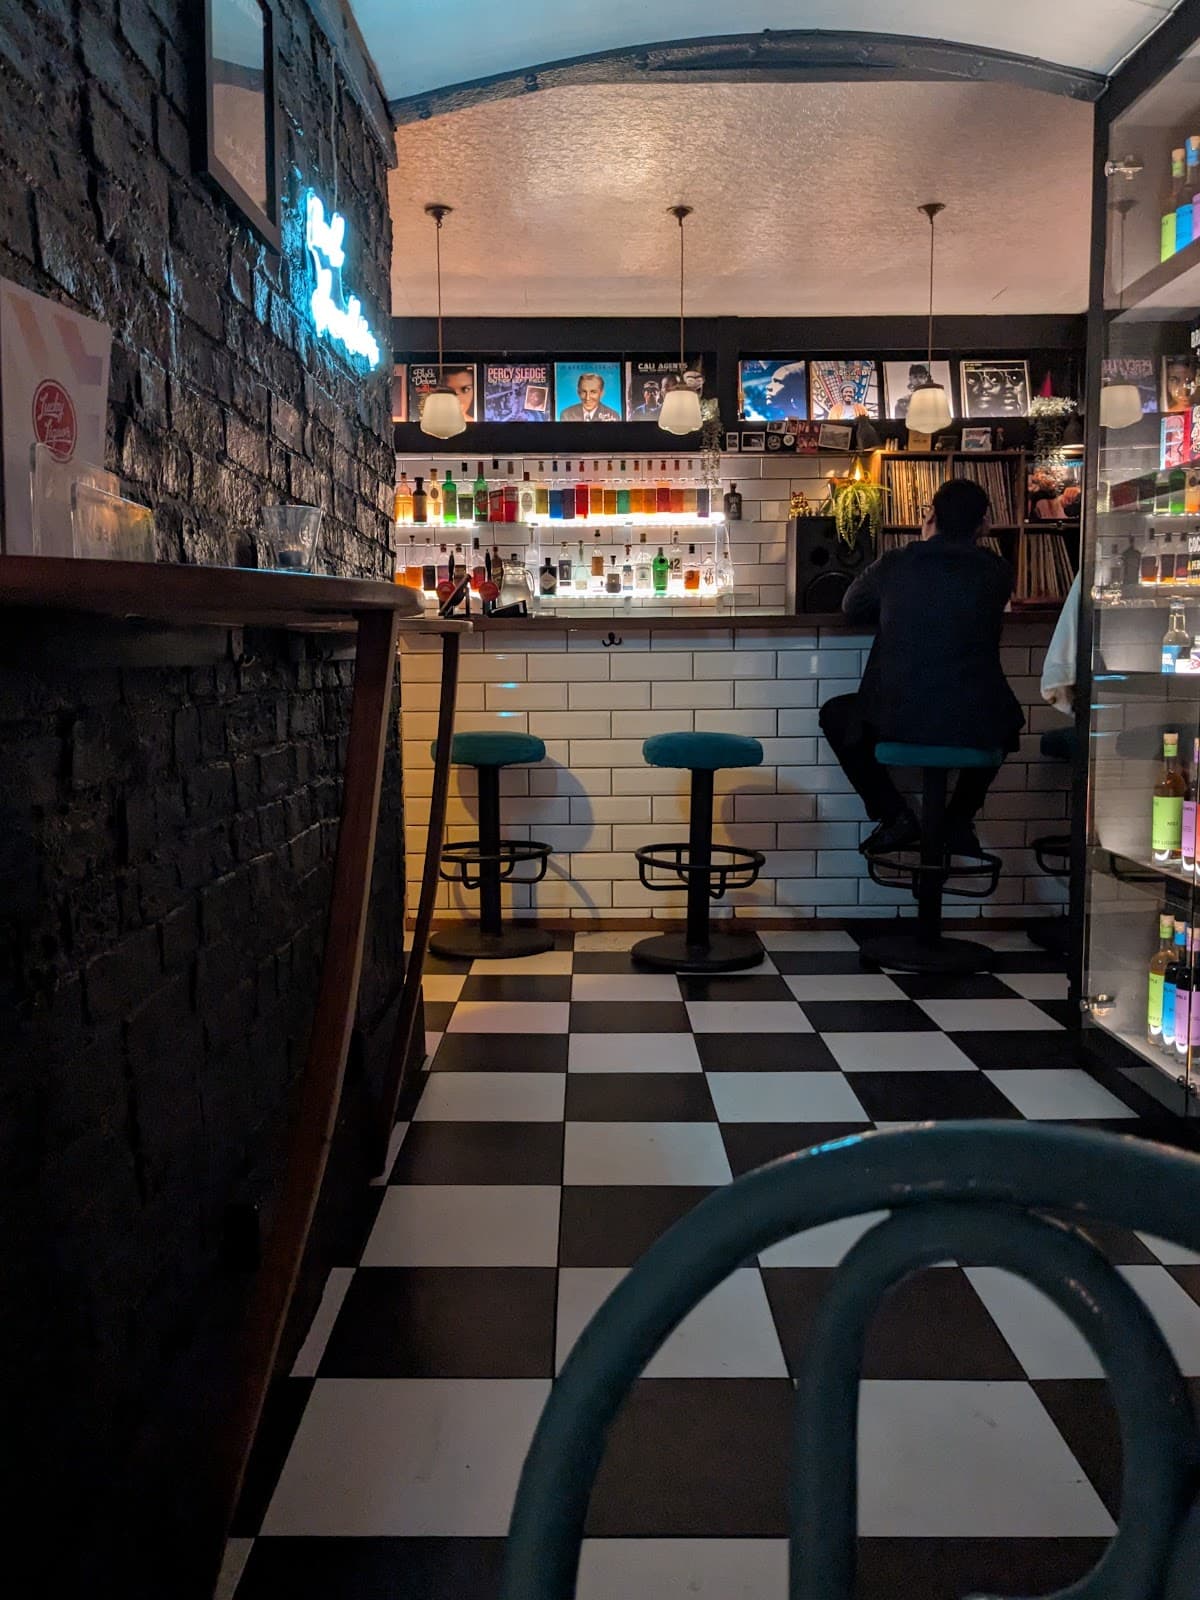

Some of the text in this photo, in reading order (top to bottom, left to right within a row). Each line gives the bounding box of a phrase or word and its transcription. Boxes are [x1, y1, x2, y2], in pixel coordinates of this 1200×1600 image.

[487, 367, 514, 379] PERCY
[515, 367, 546, 379] SLEDGE
[38, 392, 64, 422] Lucky
